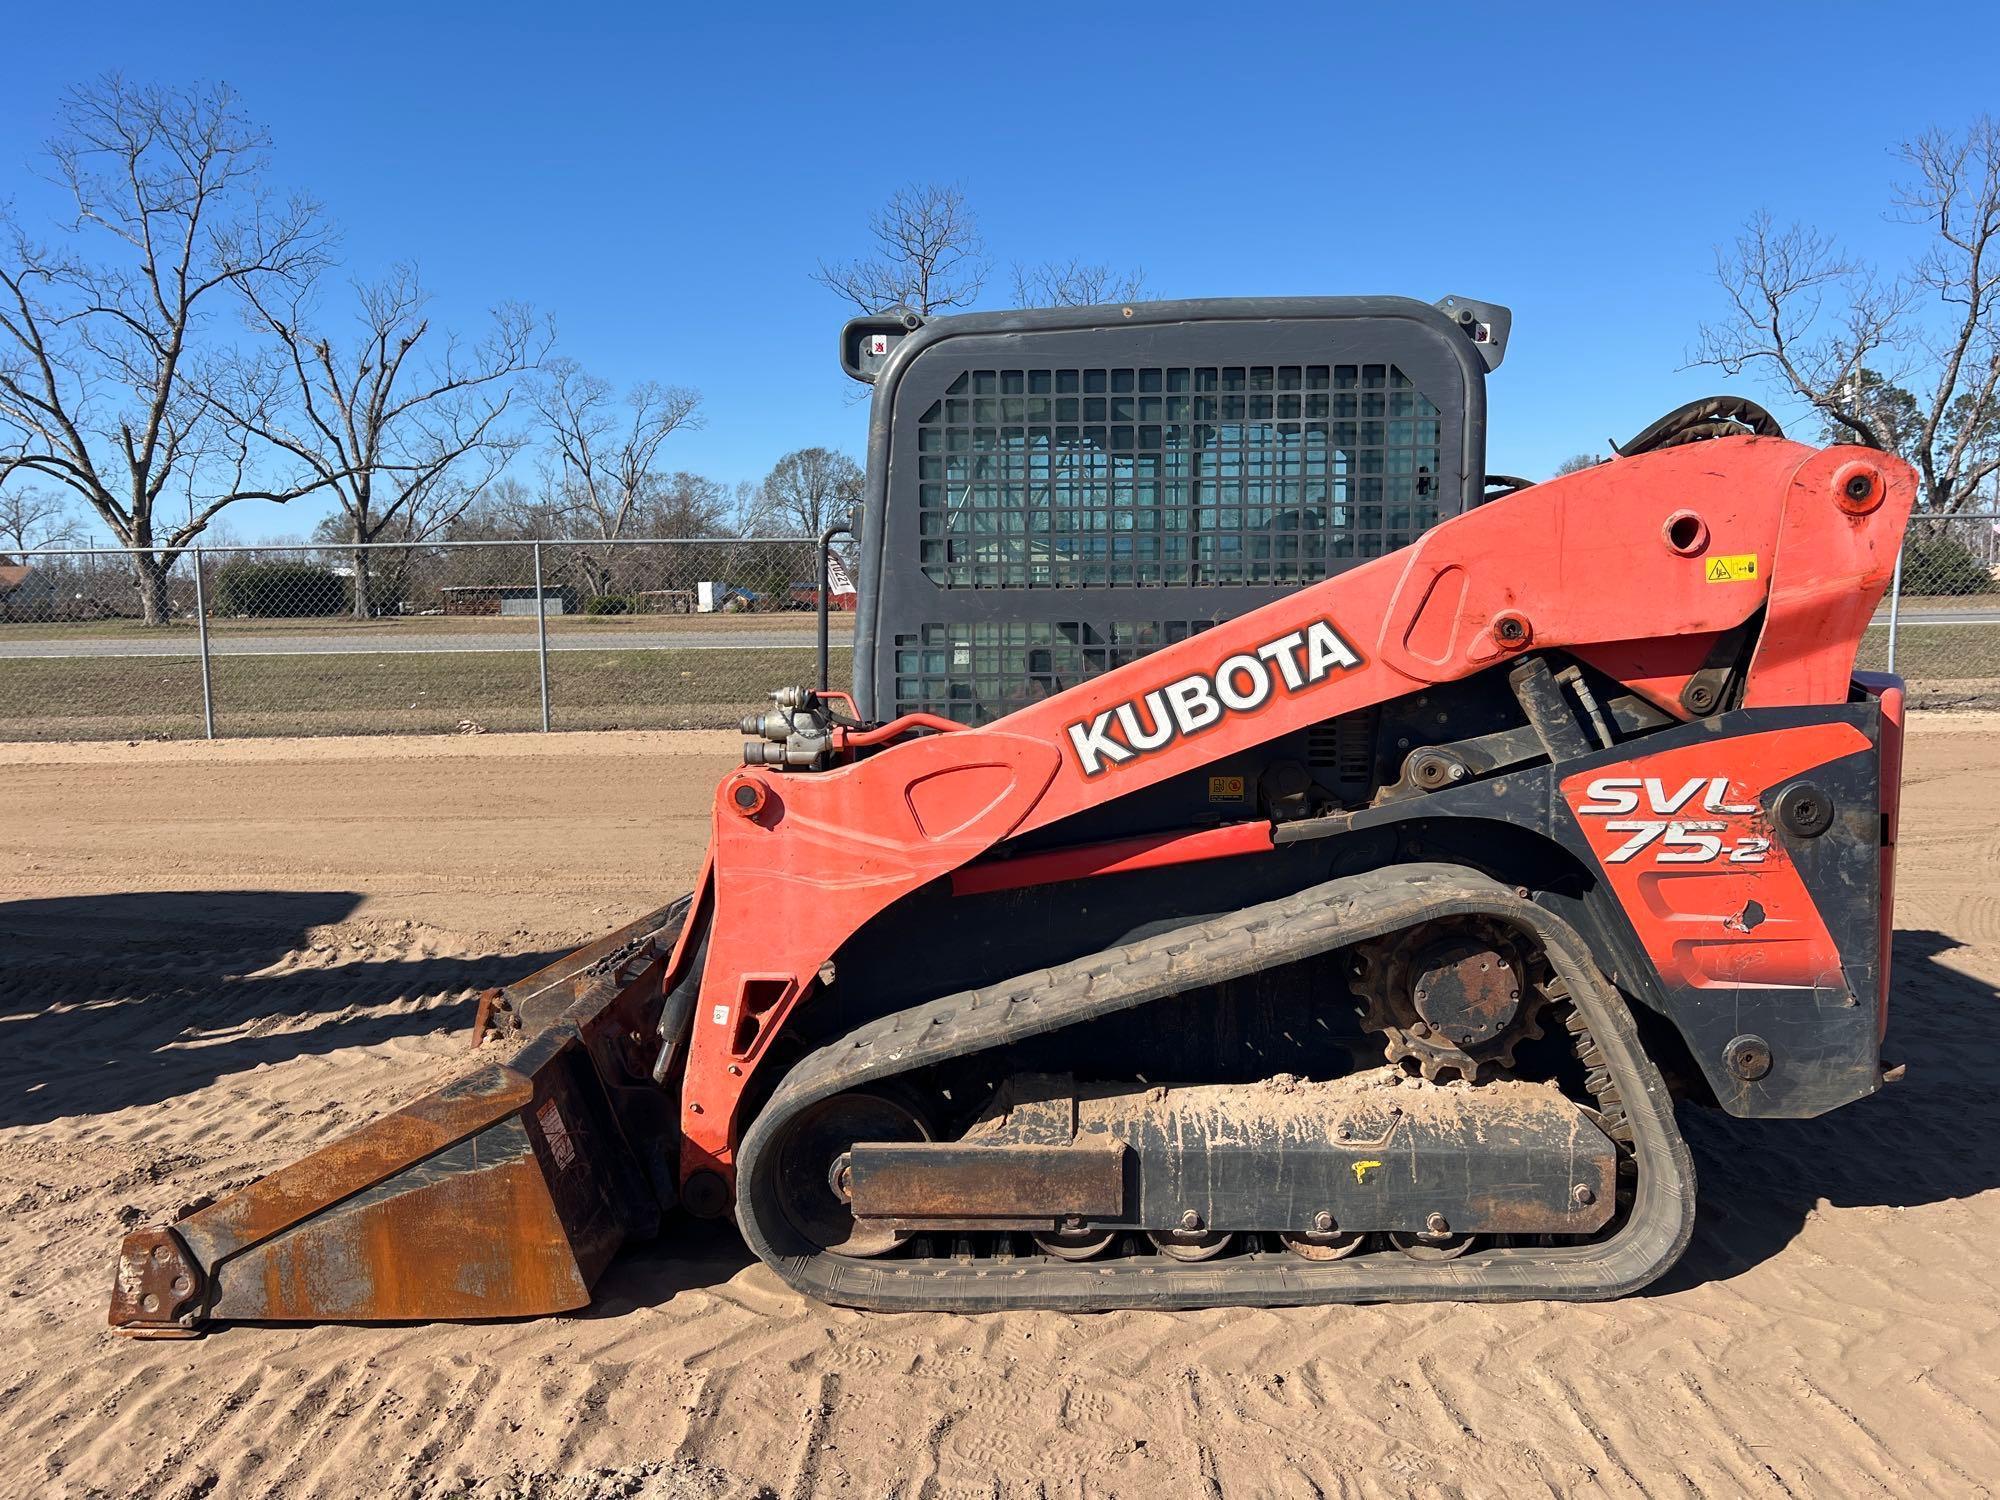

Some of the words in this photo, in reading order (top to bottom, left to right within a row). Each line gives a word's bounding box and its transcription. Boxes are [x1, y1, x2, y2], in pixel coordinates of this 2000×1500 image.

[1067, 619, 1361, 776] KUBOTA
[1577, 777, 1757, 815] SVL
[1603, 820, 1771, 864] 75-2
